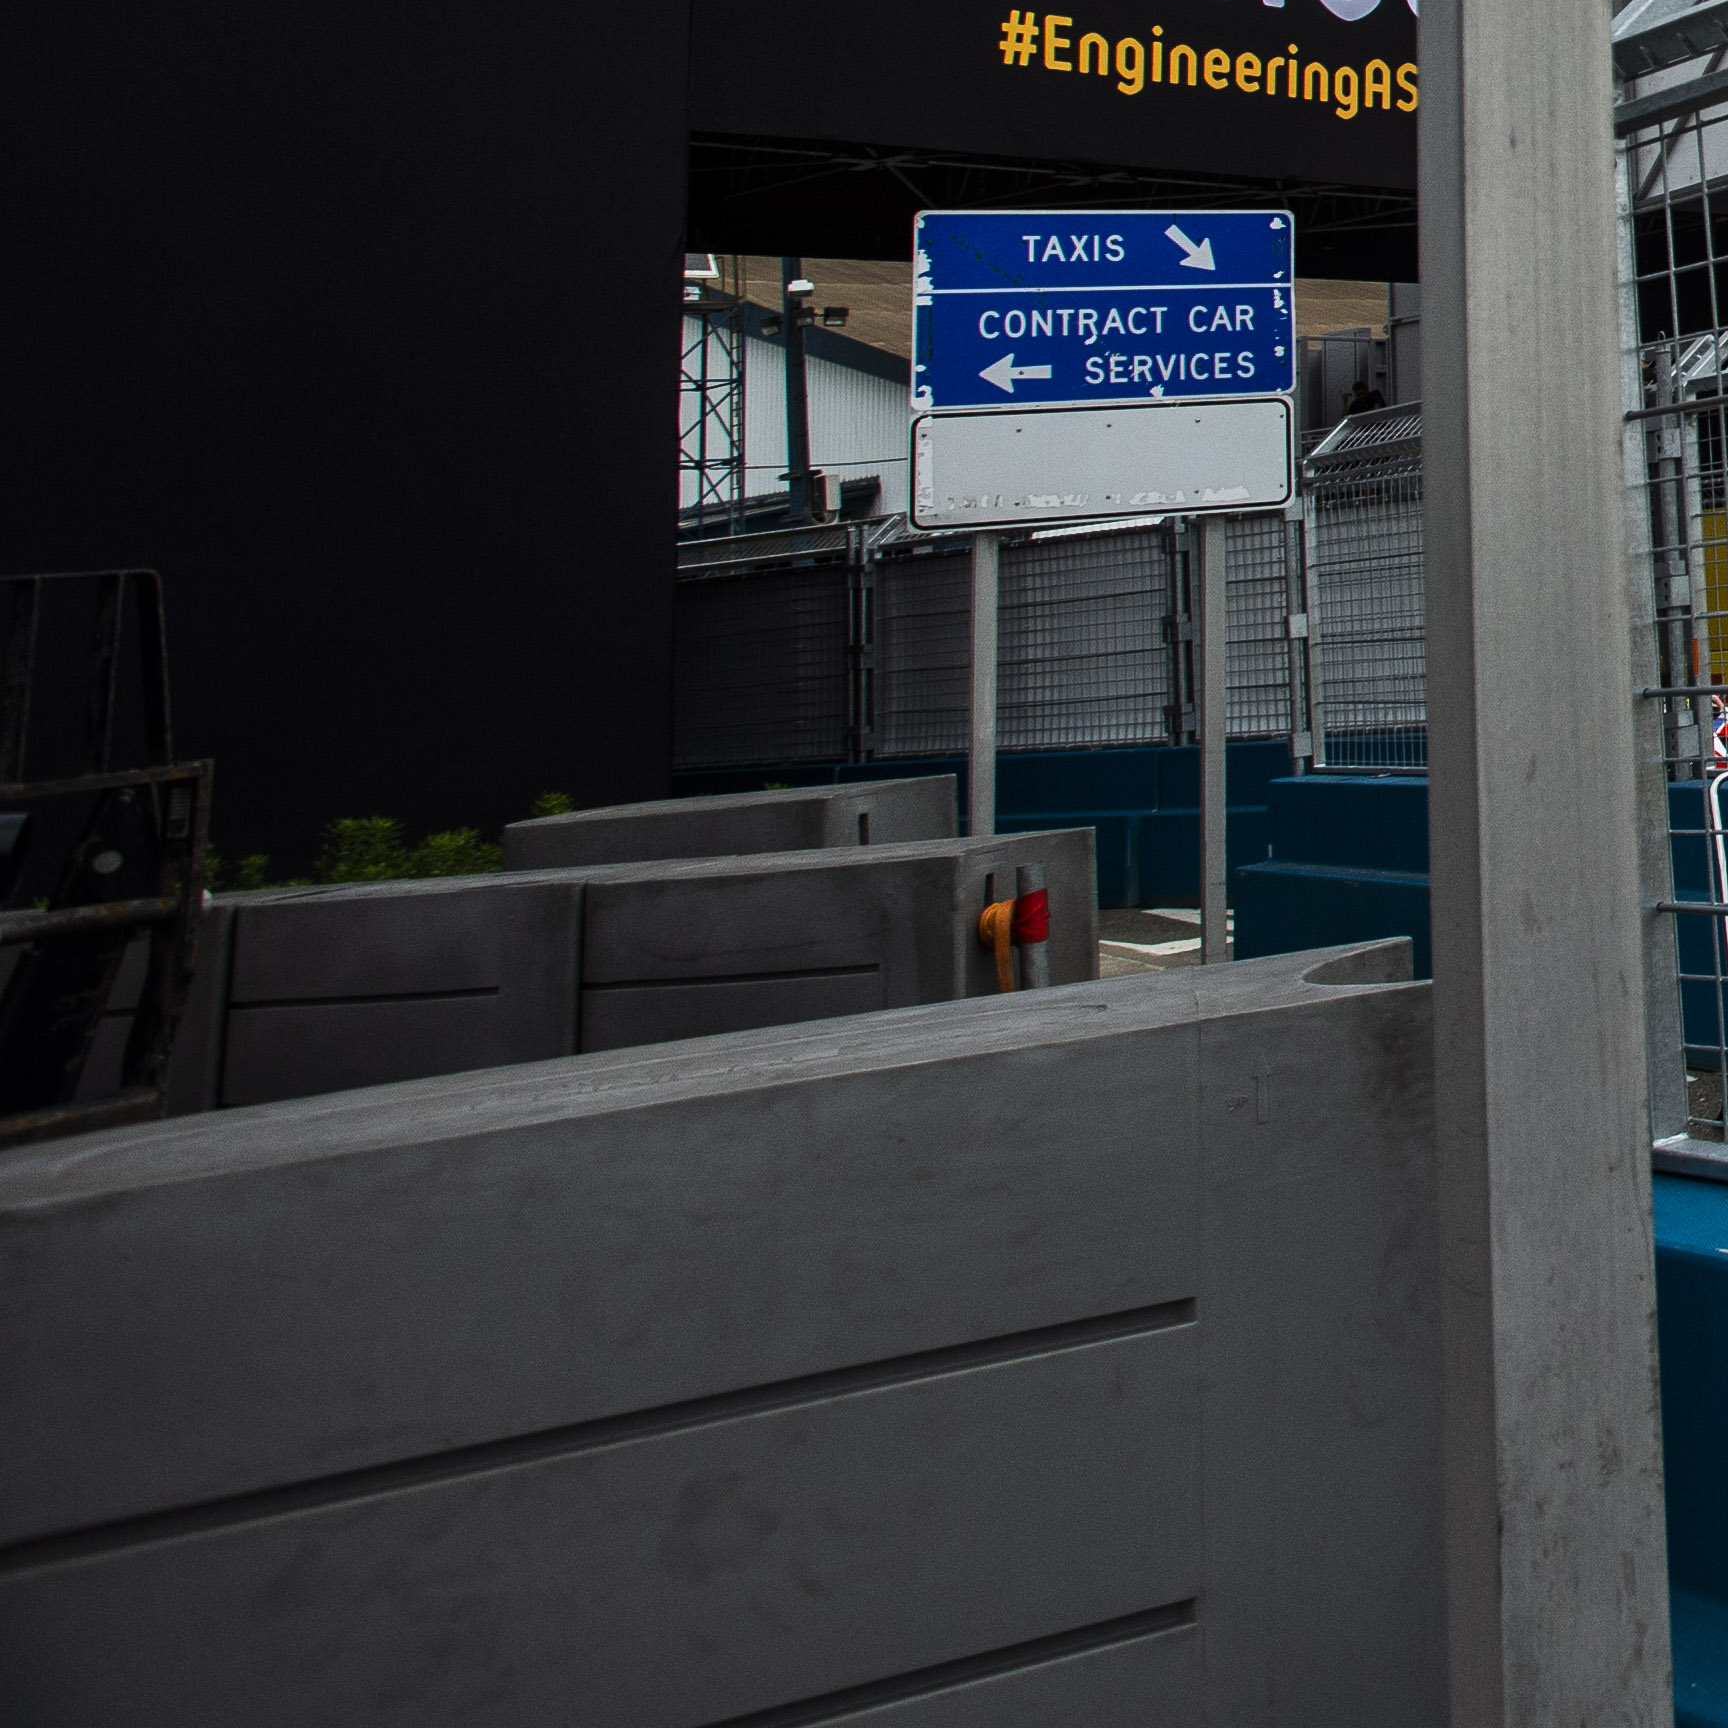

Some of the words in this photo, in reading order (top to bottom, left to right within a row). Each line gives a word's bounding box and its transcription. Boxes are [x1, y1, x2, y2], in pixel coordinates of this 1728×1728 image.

[1021, 234, 1126, 262] TAXIS
[978, 306, 1169, 339] CONTRACT
[1188, 304, 1255, 333] CAR
[1084, 350, 1256, 385] SERVICES
